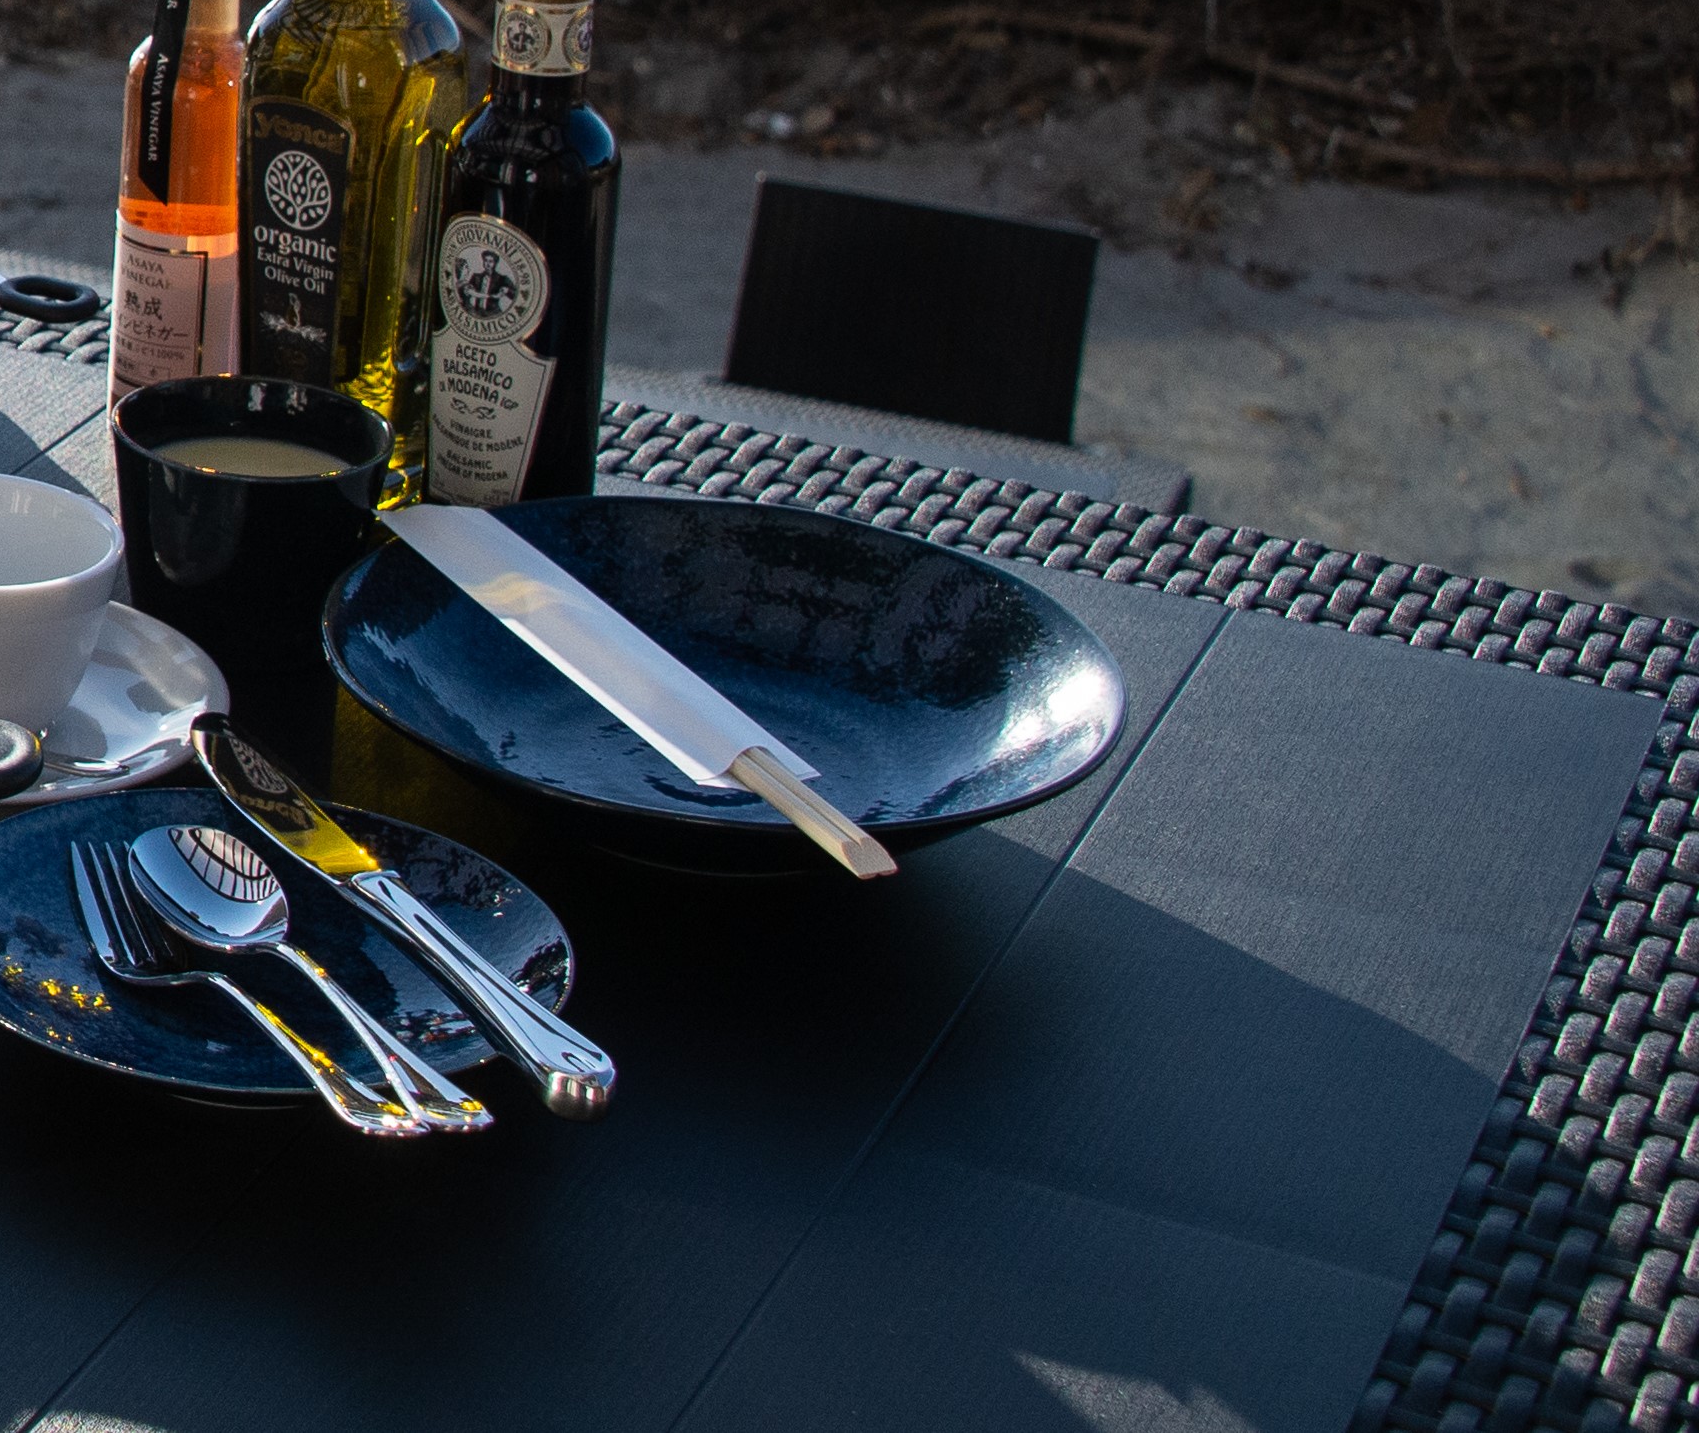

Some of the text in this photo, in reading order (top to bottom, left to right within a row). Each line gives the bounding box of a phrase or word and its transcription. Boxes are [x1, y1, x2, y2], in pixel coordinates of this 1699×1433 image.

[148, 53, 170, 162] ASAYA VINEGAR
[253, 224, 338, 263] organic
[455, 227, 519, 258] GIOVANNI
[127, 254, 165, 275] ASAYA
[257, 246, 335, 281] Extra Virgin
[264, 266, 326, 295] Olive Oil
[446, 294, 517, 334] BALSAMICO
[455, 343, 497, 367] ACETO
[443, 359, 513, 390] BALSAMICO
[448, 377, 499, 403] MODENA
